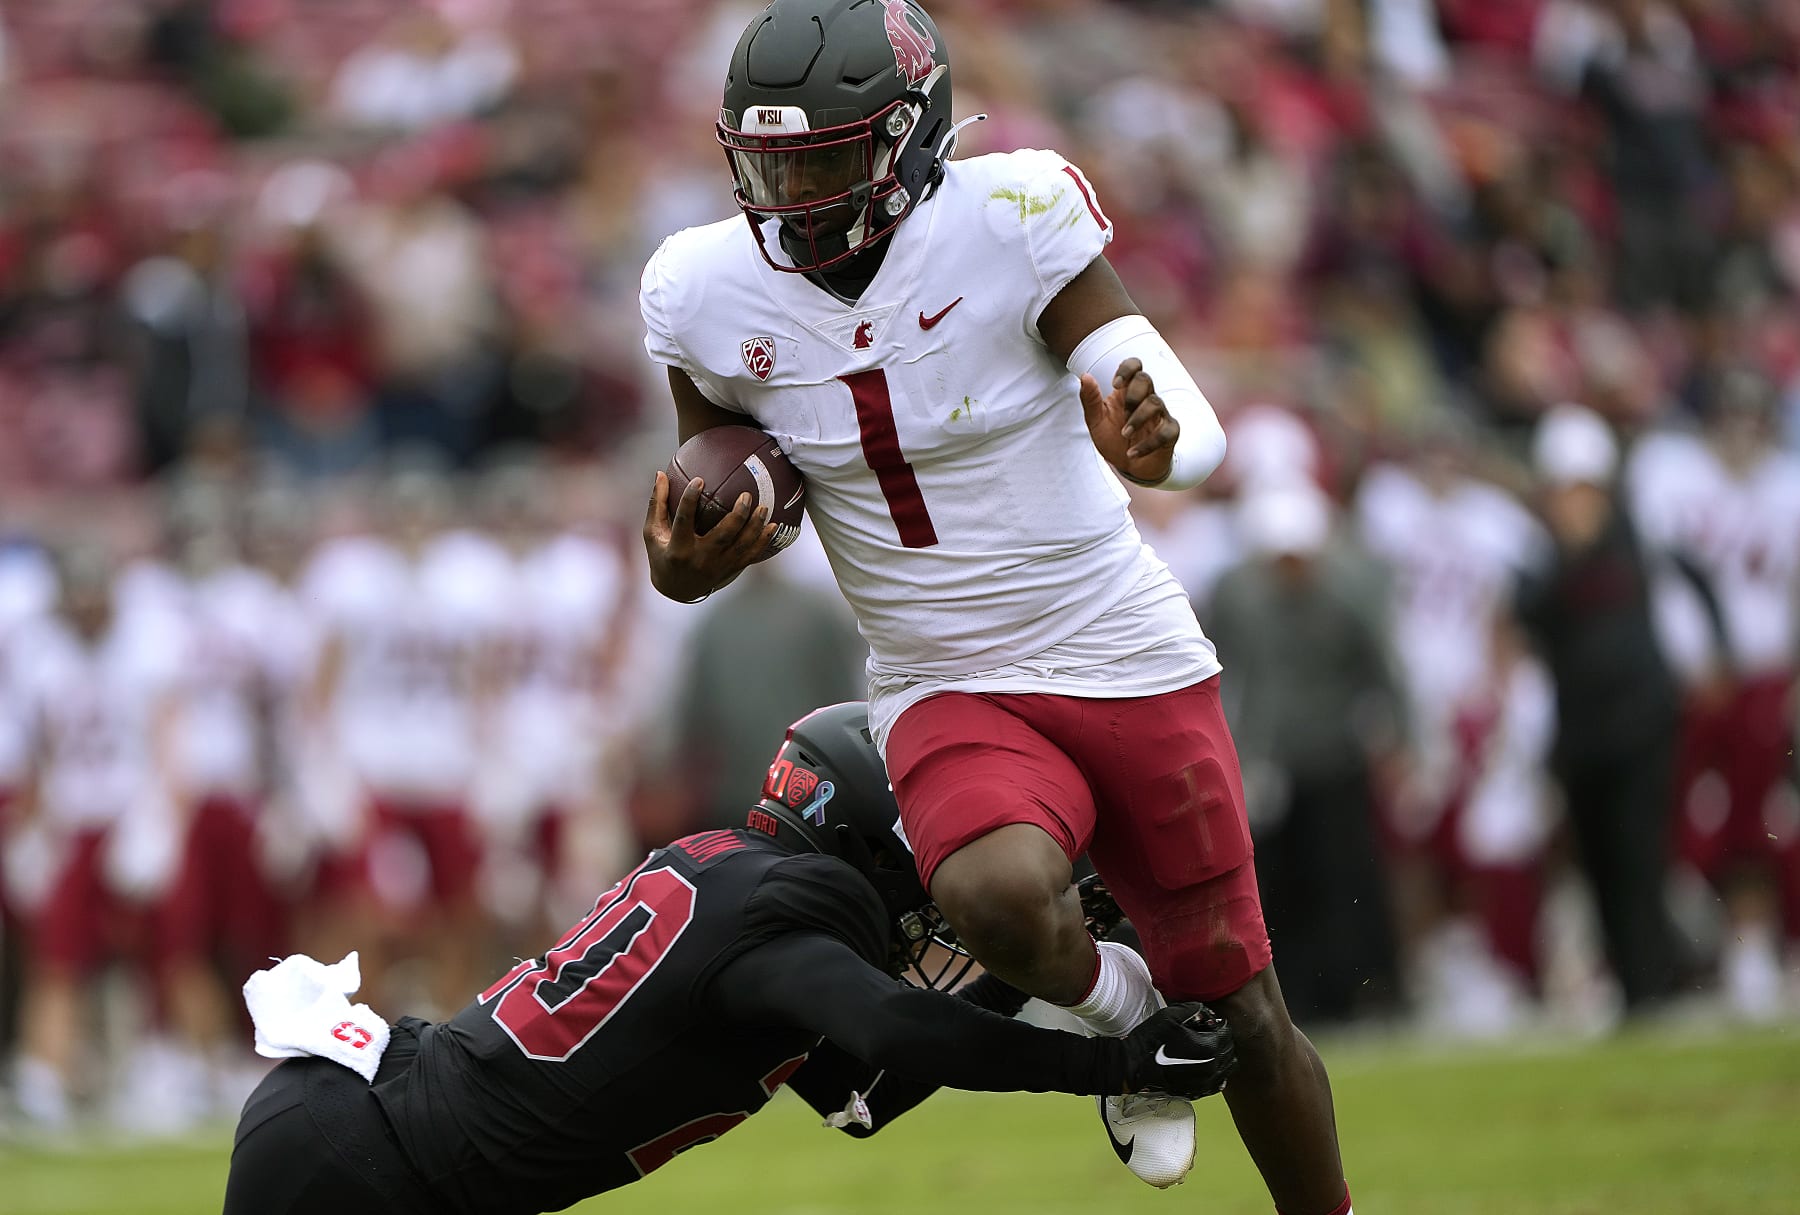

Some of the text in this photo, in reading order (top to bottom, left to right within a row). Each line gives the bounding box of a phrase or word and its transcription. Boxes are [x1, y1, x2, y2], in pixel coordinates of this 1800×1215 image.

[757, 109, 782, 125] WSU
[742, 338, 774, 365] PAC
[752, 354, 771, 373] 12
[836, 368, 938, 549] 1
